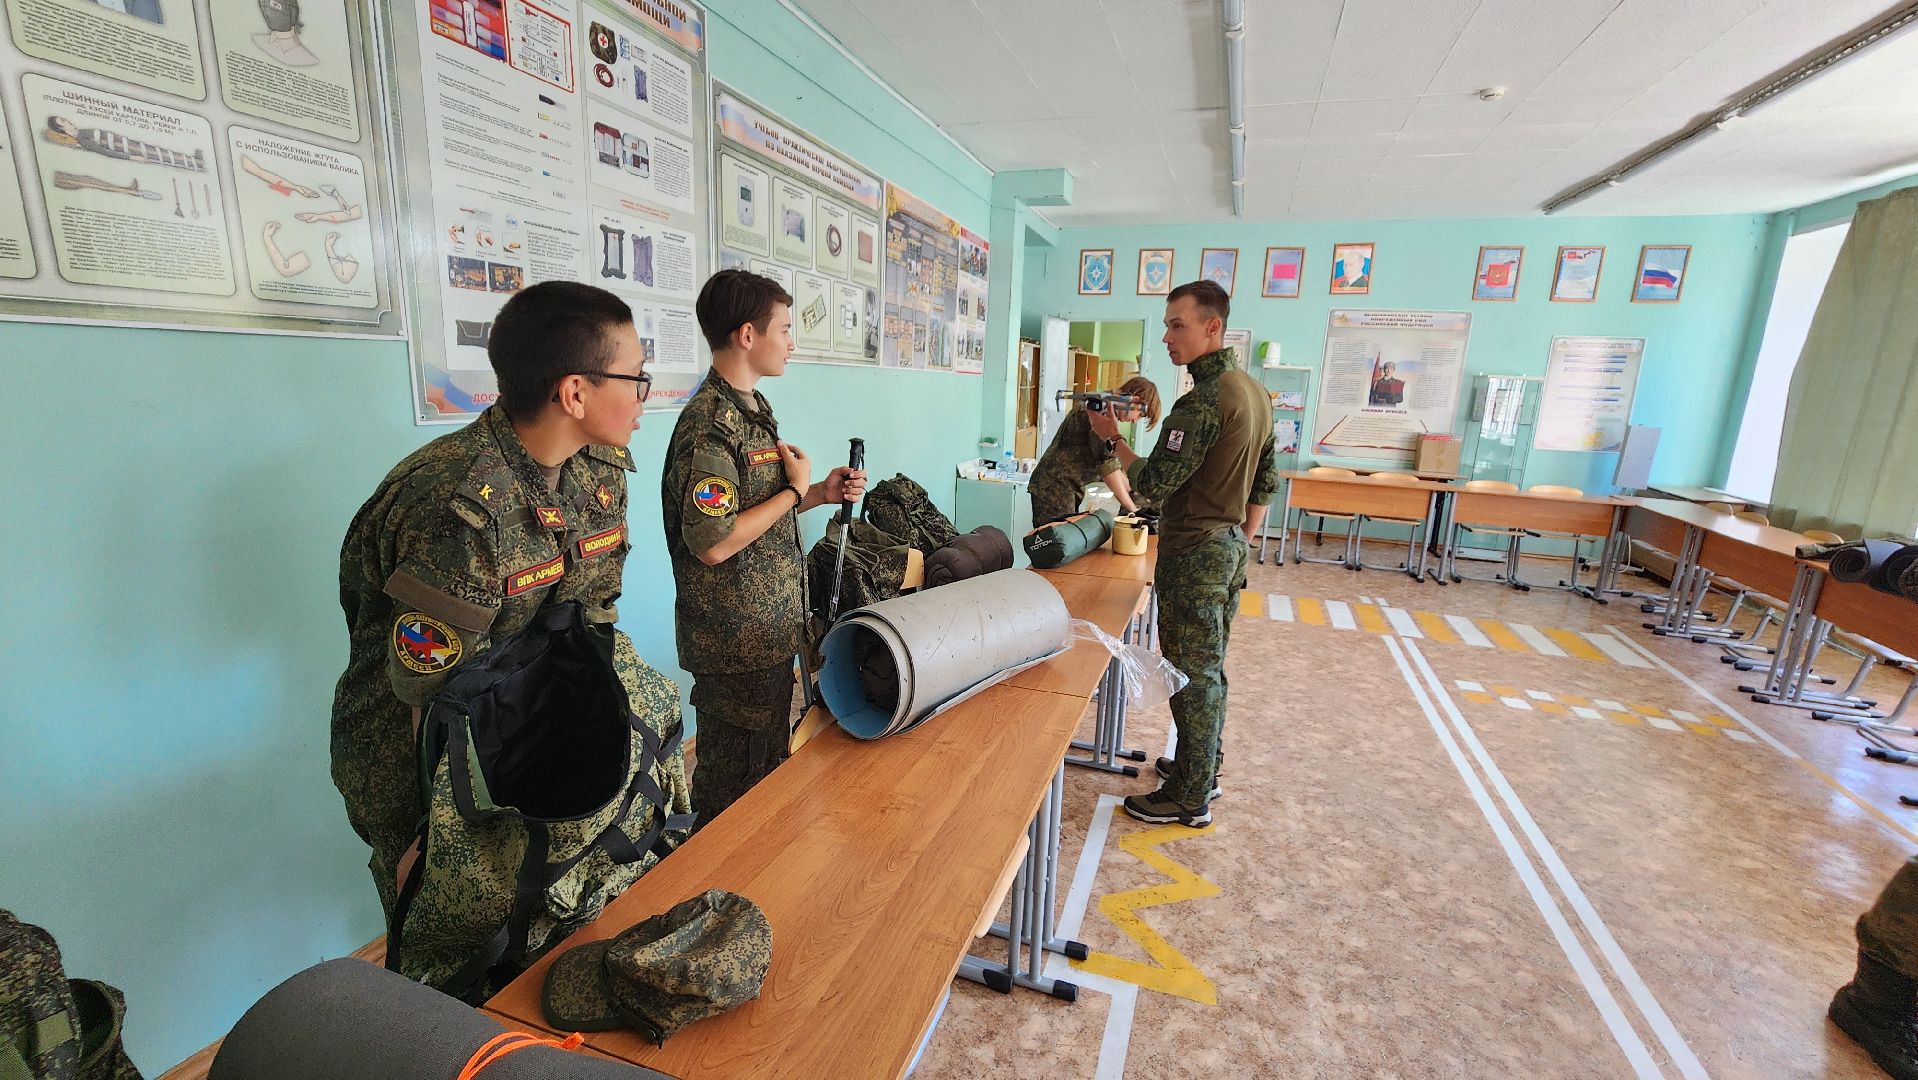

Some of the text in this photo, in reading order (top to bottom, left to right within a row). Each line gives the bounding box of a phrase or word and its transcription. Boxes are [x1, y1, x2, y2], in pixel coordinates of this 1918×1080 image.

[62, 90, 181, 125] ШИННЫЙ МАТЕРИАЛ
[112, 115, 124, 124] ОТ
[235, 140, 360, 176] С ИСПОЛЬЗОВАНИЕМ ВАЛИКА
[258, 139, 340, 164] НАЛОЖЕНИЕ ЖГУТА
[517, 562, 564, 587] ВПК АРМЕЕ
